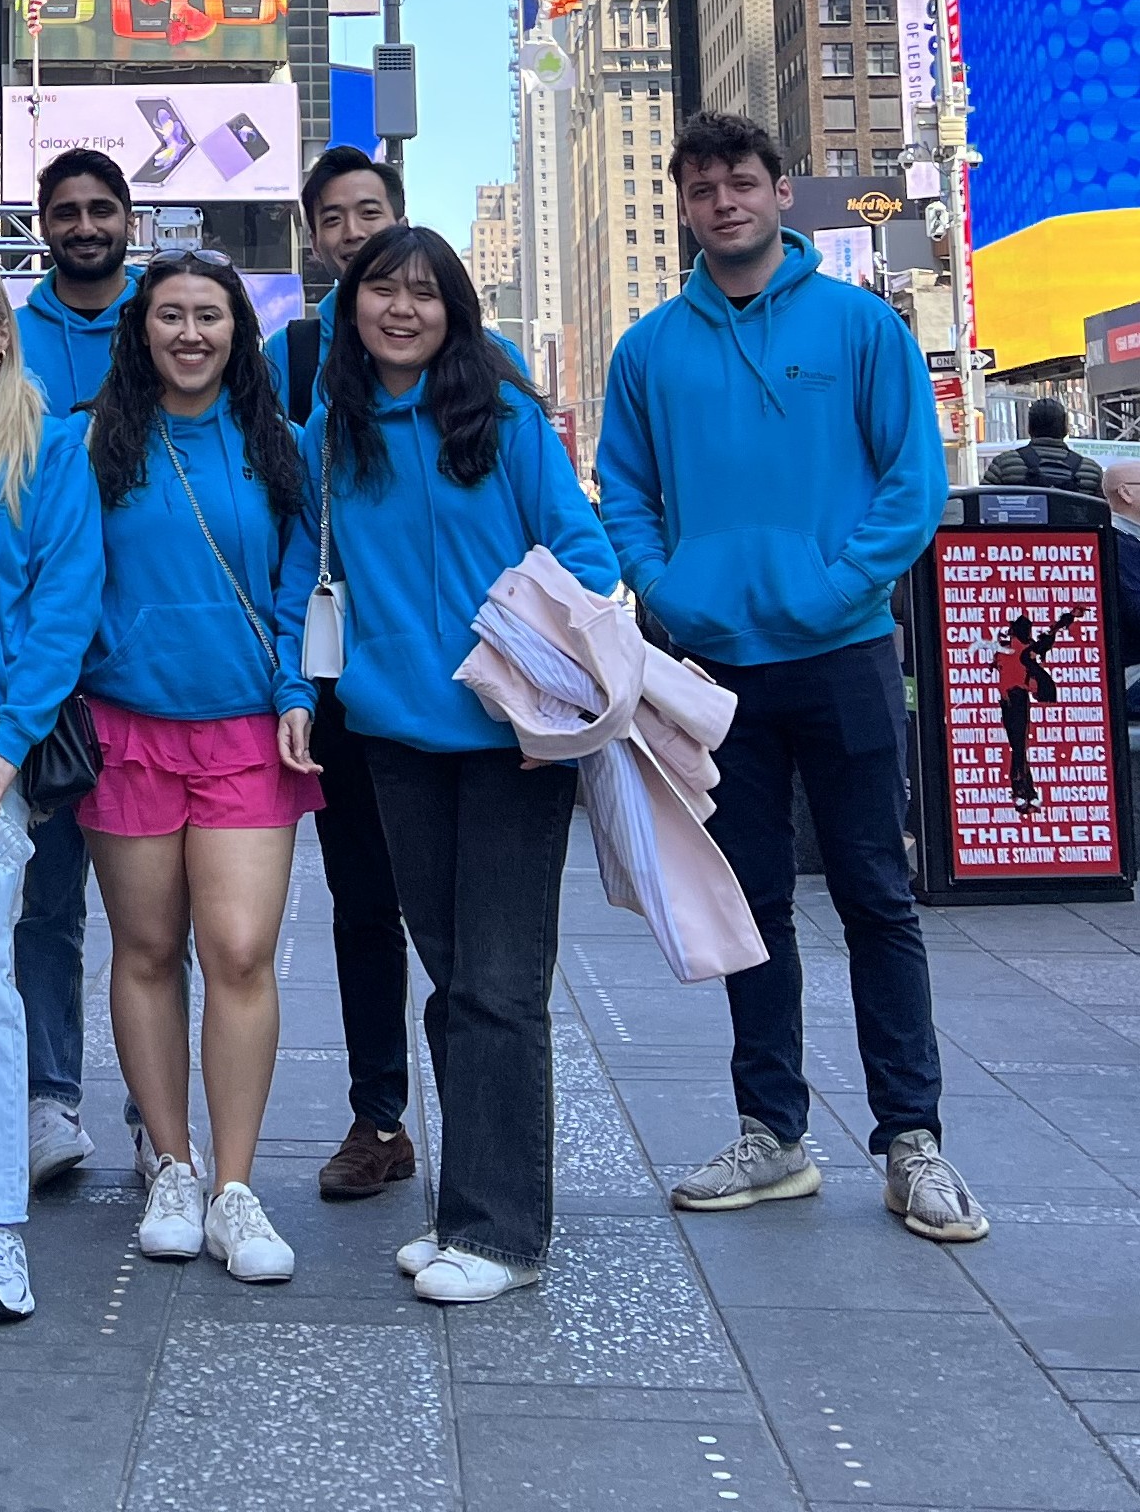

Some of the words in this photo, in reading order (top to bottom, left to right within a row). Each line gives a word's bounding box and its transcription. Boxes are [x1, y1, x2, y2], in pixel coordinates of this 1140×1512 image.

[906, 22, 920, 39] OF
[907, 43, 921, 70] LED
[81, 137, 90, 148] Z
[92, 137, 125, 150] Flip4
[846, 198, 875, 211] Hard
[875, 197, 903, 212] Rock
[936, 358, 956, 366] ONE
[942, 546, 976, 562] JAM
[987, 546, 1024, 561] BAD
[1032, 545, 1094, 561] MONEY
[943, 566, 993, 581] KEEP
[996, 566, 1035, 581] THE
[1039, 566, 1095, 581] FAITH
[944, 587, 977, 603] BILLIE
[978, 587, 1006, 603] JEAN
[1017, 587, 1022, 602] I
[1023, 587, 1049, 602] WANT
[1051, 587, 1070, 602] YOU
[1072, 587, 1097, 602] BACK
[945, 607, 985, 623] BLAME
[989, 607, 1002, 622] IT
[1026, 607, 1050, 622] THE
[946, 626, 983, 643] CAN
[1045, 648, 1081, 664] ABOUT
[1084, 648, 1100, 662] US
[950, 688, 984, 704] MAN
[1056, 687, 1102, 702] IRROR
[950, 708, 978, 724] DON'T
[1045, 707, 1063, 722] GET
[1065, 706, 1104, 722] ENOUGH
[952, 728, 986, 744] SMOOTH
[1036, 727, 1063, 742] BLACK
[1064, 727, 1077, 742] OR
[1078, 726, 1105, 742] WHITE
[953, 748, 979, 764] I'LL
[984, 747, 1003, 763] BE
[1070, 746, 1106, 762] ABC
[954, 768, 985, 784] BEAT
[988, 768, 1001, 783] IT
[1060, 766, 1108, 782] NATURE
[955, 787, 1013, 804] STRANGE
[1050, 785, 1109, 802] MOSCOW
[1047, 807, 1069, 822] LOVE
[1069, 807, 1087, 821] YOU
[1088, 806, 1110, 821] SAVE
[957, 825, 1111, 844] THRILLER
[958, 848, 995, 865] WANNA
[996, 848, 1010, 864] BE
